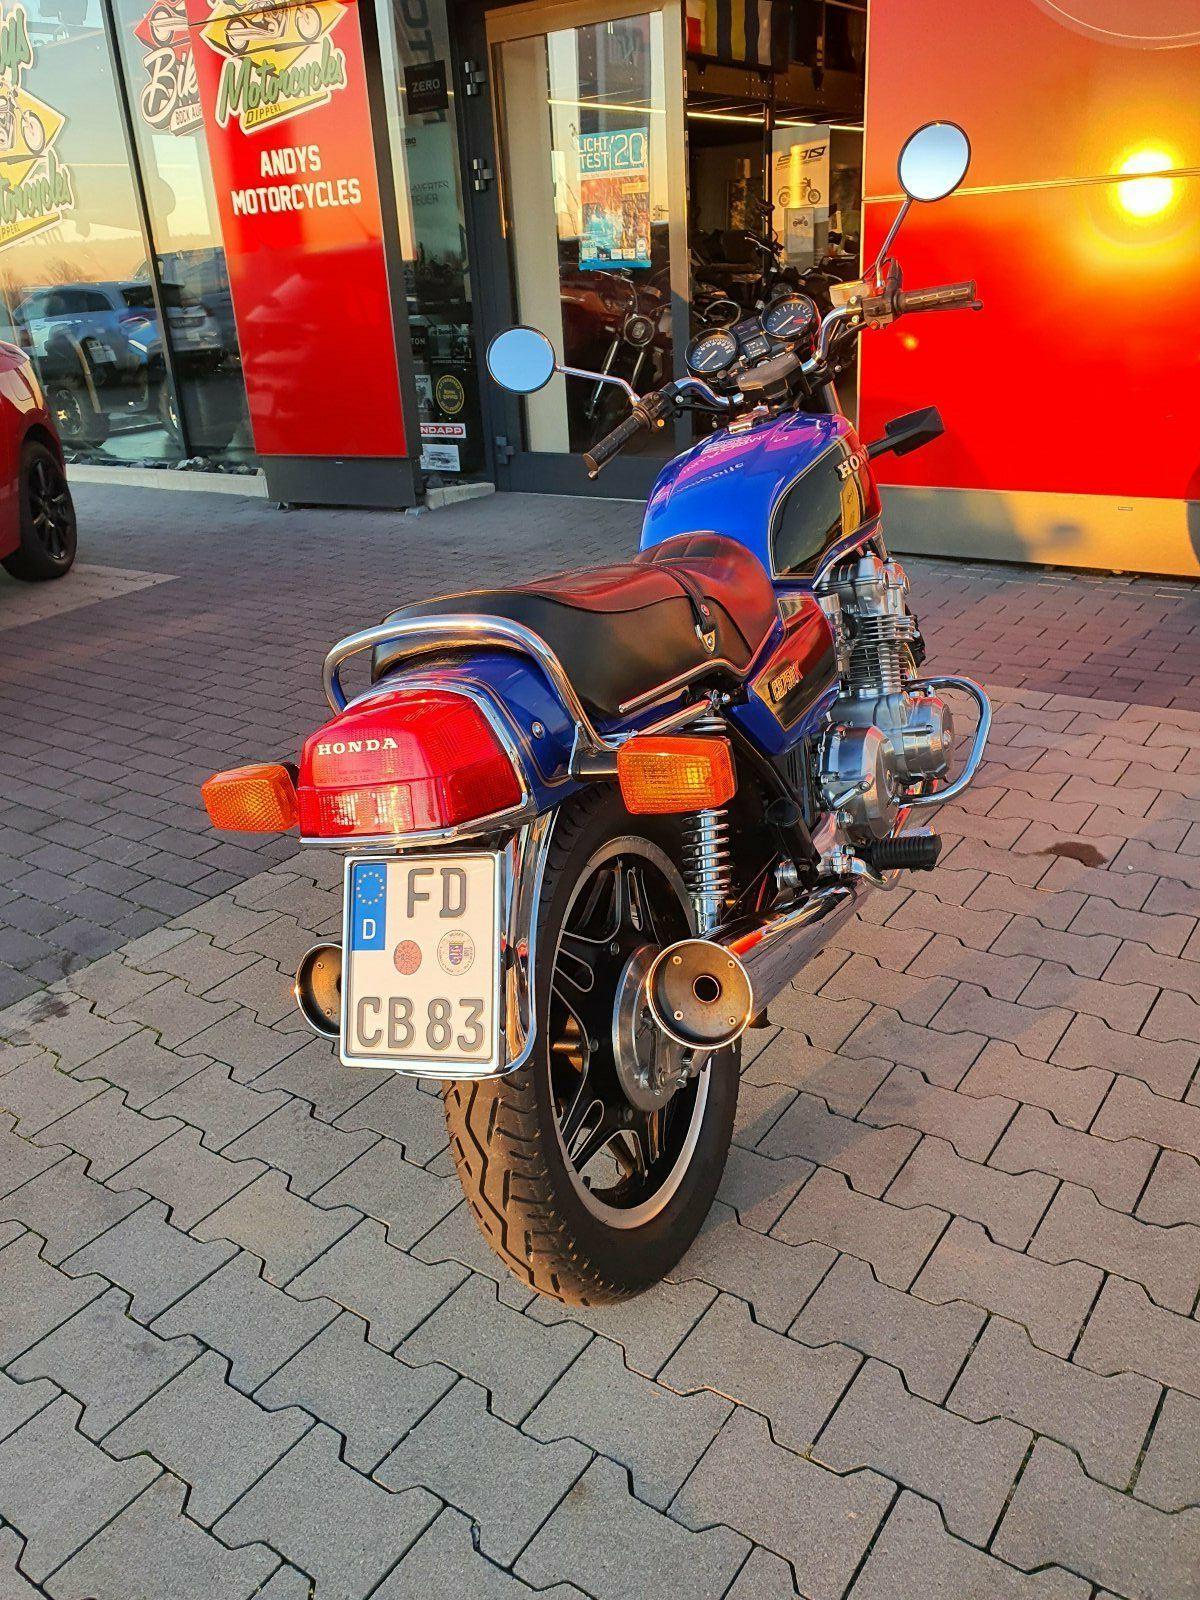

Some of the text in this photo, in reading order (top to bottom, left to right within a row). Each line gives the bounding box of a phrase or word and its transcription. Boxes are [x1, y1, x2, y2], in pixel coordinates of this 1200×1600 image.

[218, 37, 345, 123] Motorcycles
[411, 79, 440, 93] ZERO
[260, 144, 321, 178] ANDYS
[579, 152, 609, 169] TEST
[231, 179, 362, 216] MOTORCYCLES
[420, 426, 462, 435] NDAPP
[317, 737, 398, 756] HONDA
[406, 867, 467, 919] FD
[361, 918, 377, 940] D
[356, 996, 485, 1051] CB 83
